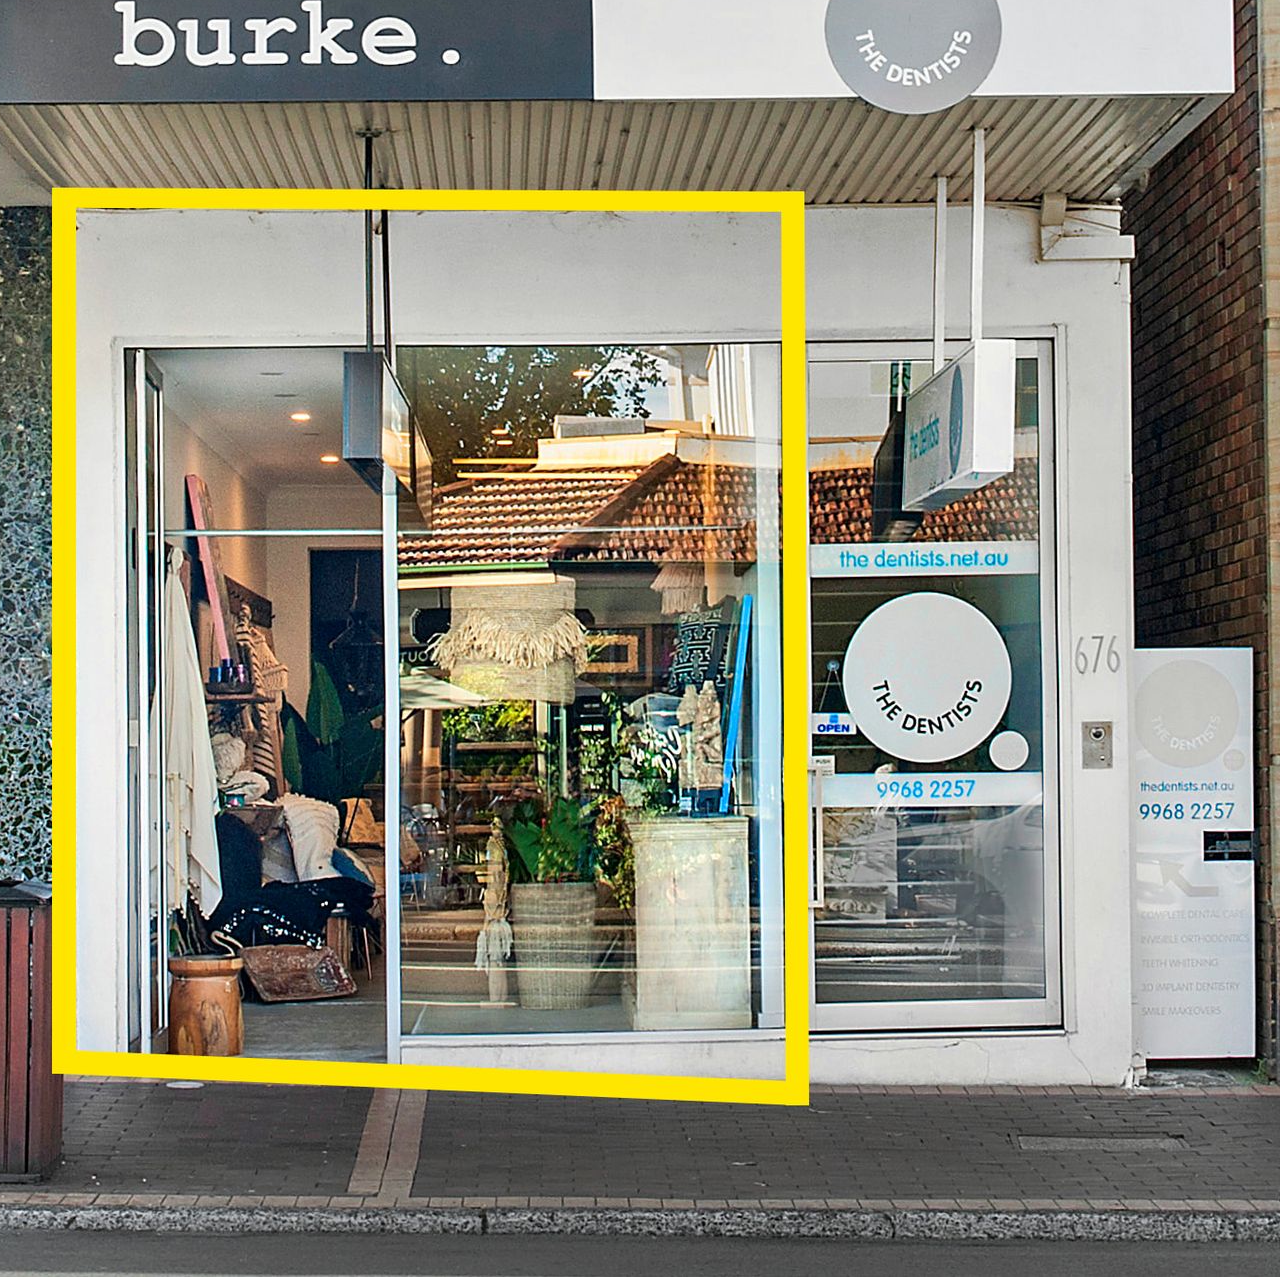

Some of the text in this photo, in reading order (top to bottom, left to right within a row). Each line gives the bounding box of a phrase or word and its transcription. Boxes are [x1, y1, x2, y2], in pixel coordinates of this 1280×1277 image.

[855, 29, 972, 86] THE DENTISTS
[839, 549, 1008, 568] the dentists.net.au
[1075, 635, 1120, 674] 676
[873, 679, 982, 734] THE DENTISTS
[817, 724, 850, 732] OPEN
[1151, 715, 1220, 751] THE DENTISTS
[877, 780, 976, 798] 9968 2257
[1140, 781, 1235, 793] thedentists.net.au
[1139, 803, 1235, 820] 9968 2257
